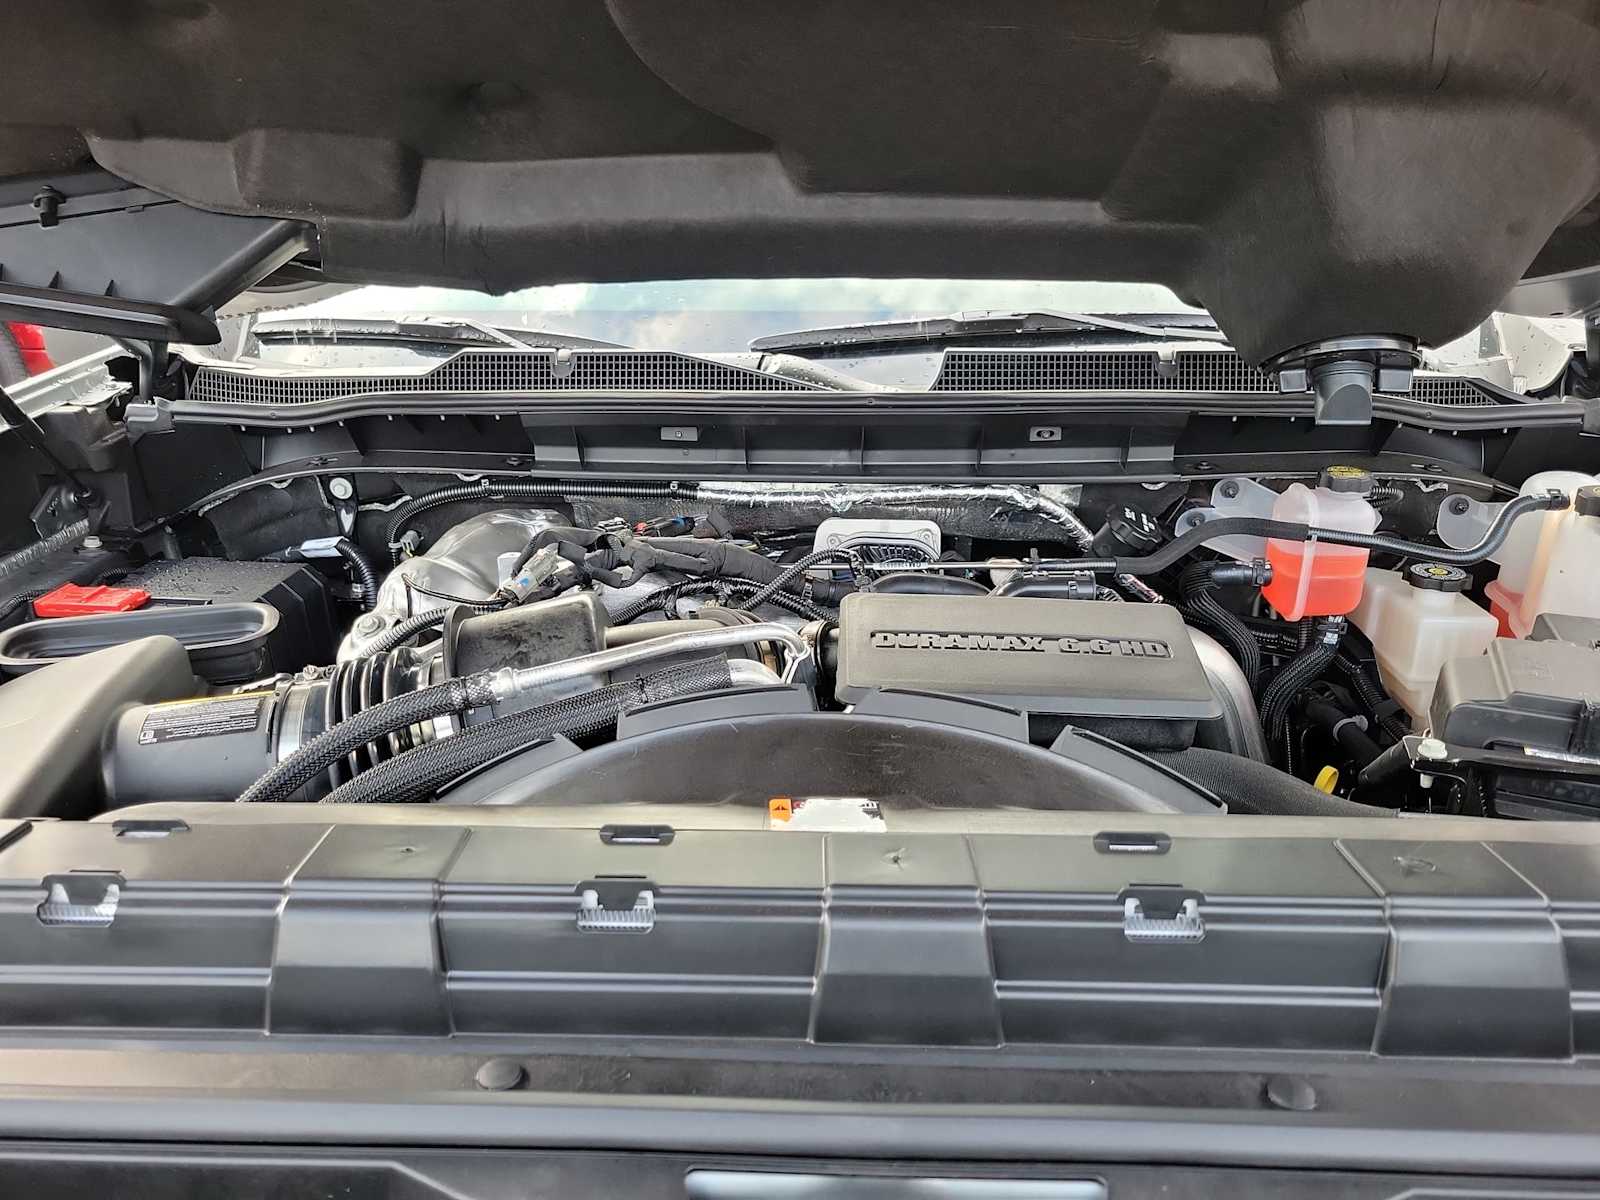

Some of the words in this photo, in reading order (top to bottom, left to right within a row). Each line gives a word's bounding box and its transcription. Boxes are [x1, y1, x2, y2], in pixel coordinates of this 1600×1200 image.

[873, 631, 1045, 652] DURAMAX
[1058, 637, 1112, 655] 6.6
[1119, 640, 1172, 657] HD
